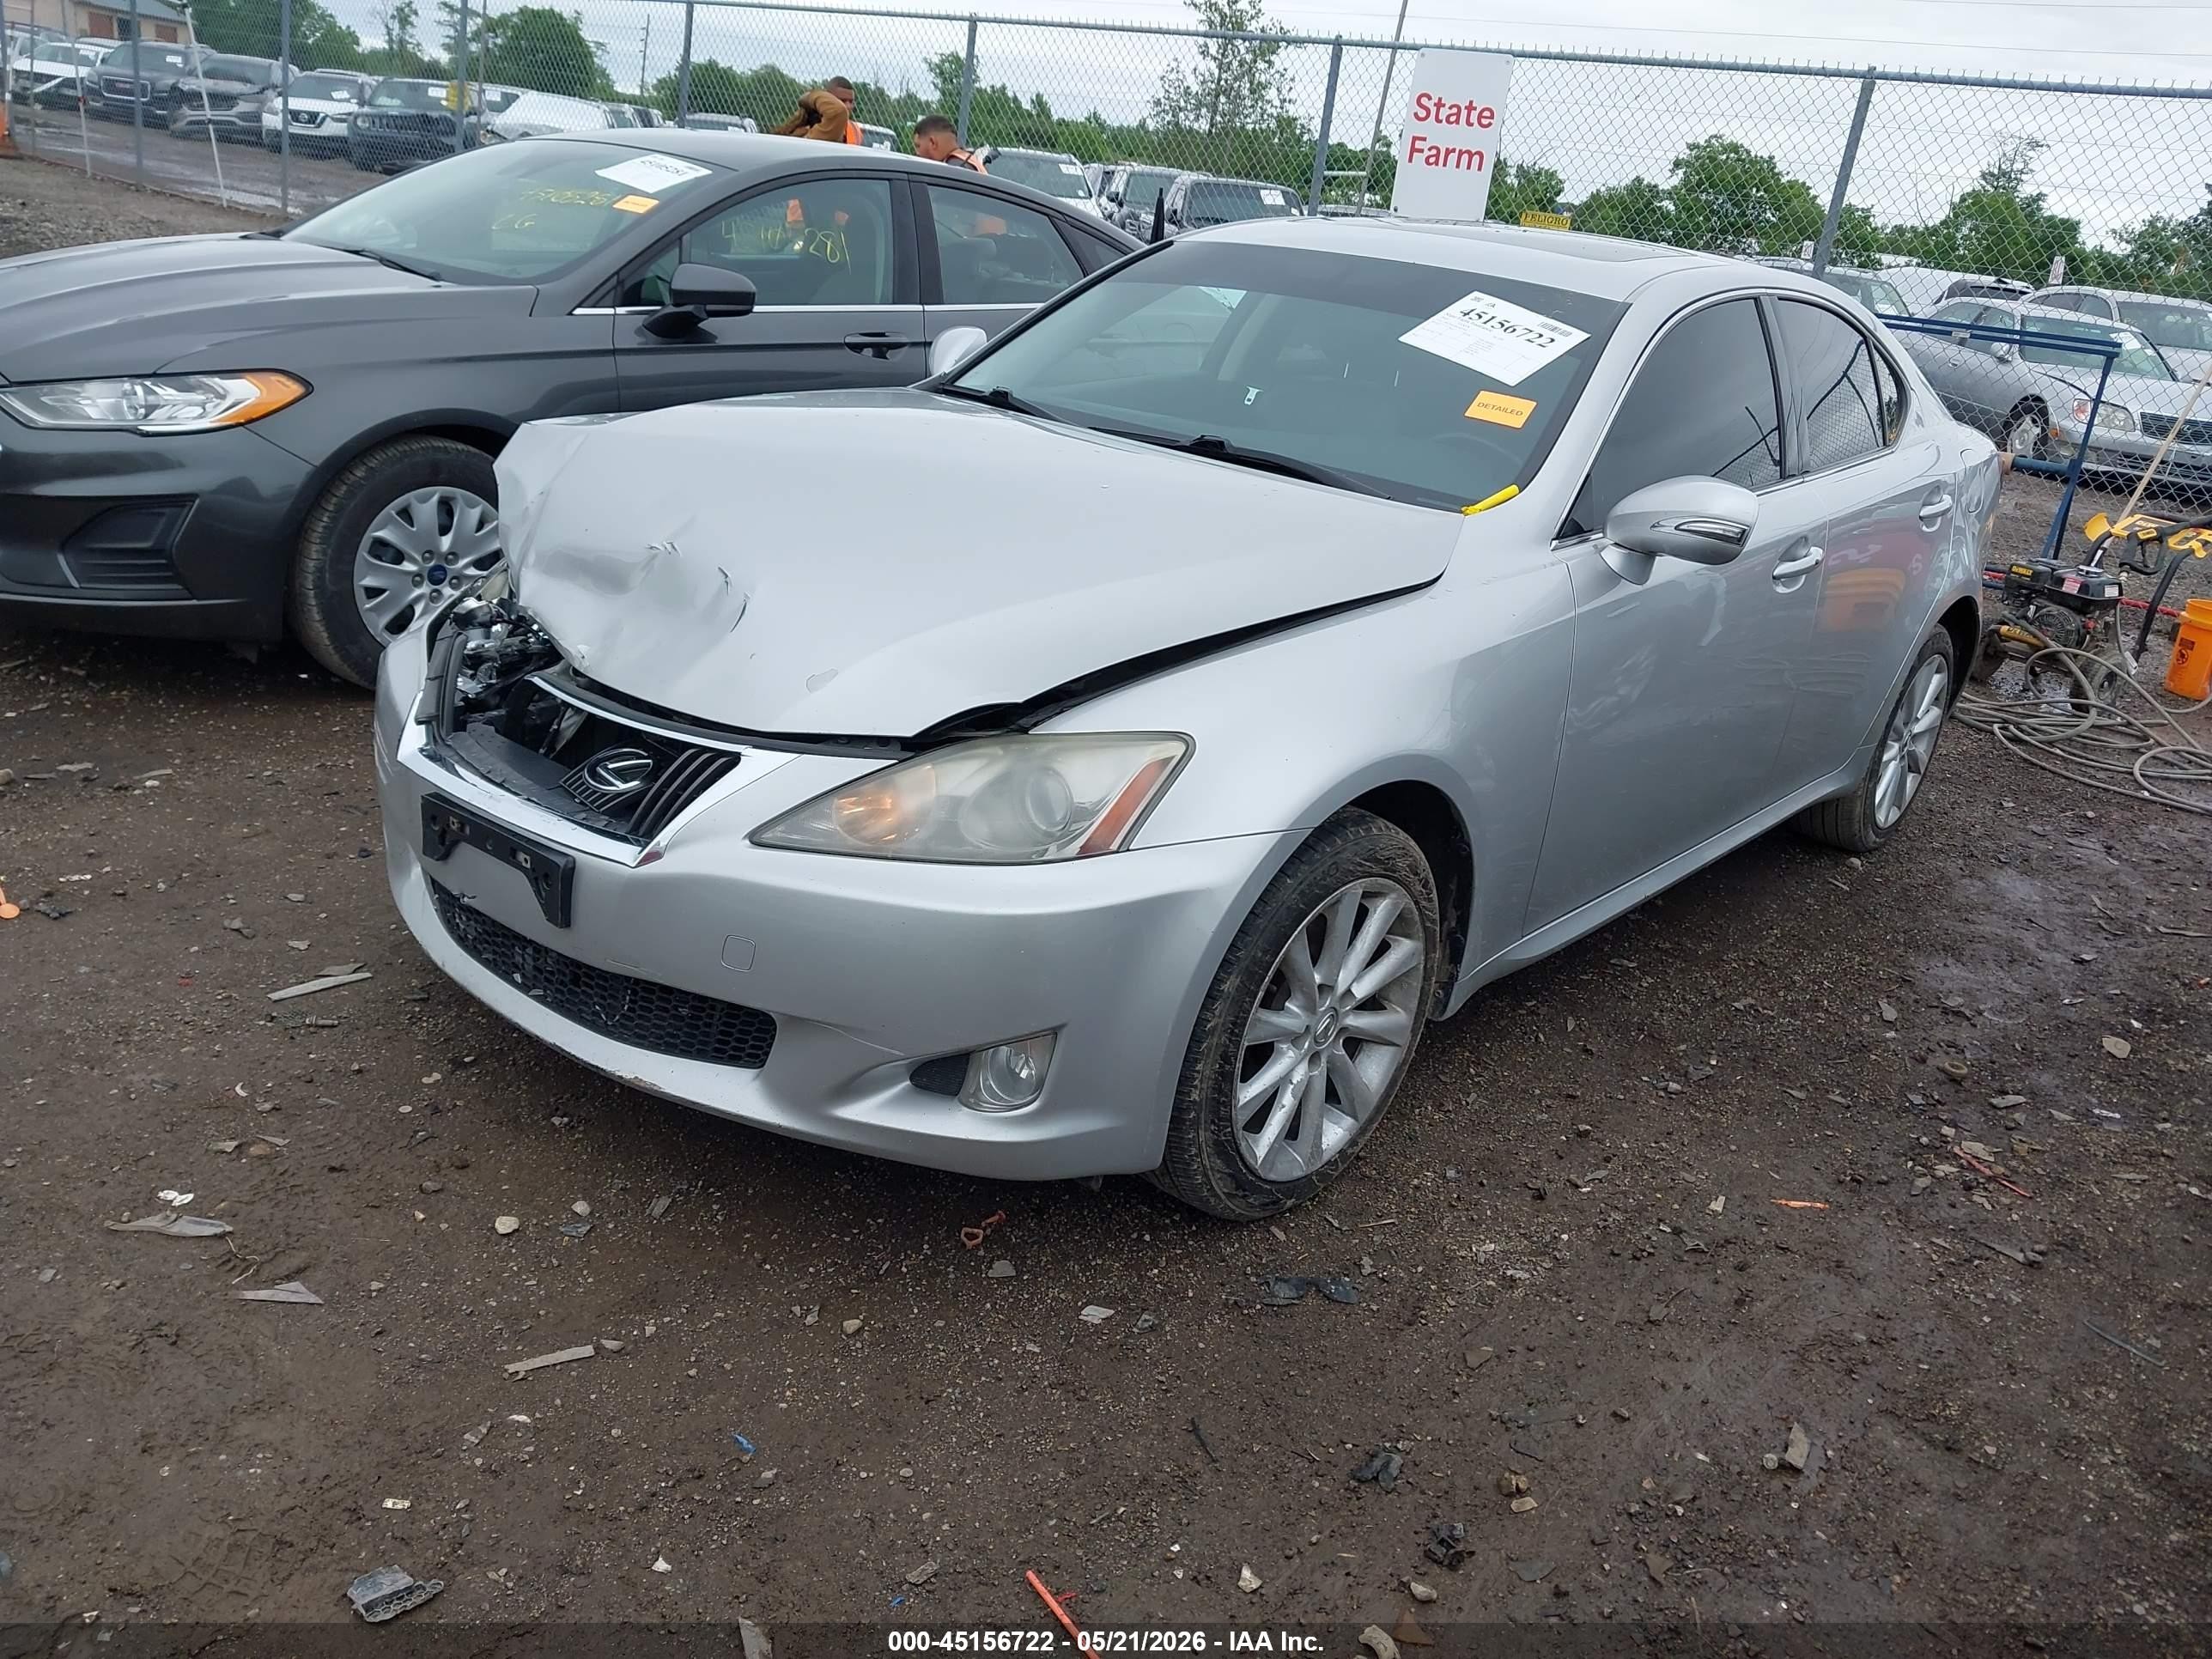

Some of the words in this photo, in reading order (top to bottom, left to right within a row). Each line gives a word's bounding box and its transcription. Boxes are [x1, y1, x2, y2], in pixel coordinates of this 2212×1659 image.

[1413, 92, 1495, 129] State
[1408, 135, 1485, 173] Farm
[1524, 212, 1569, 226] PELIGRO
[1459, 307, 1556, 349] 45156722
[1476, 402, 1523, 416] DETAILED
